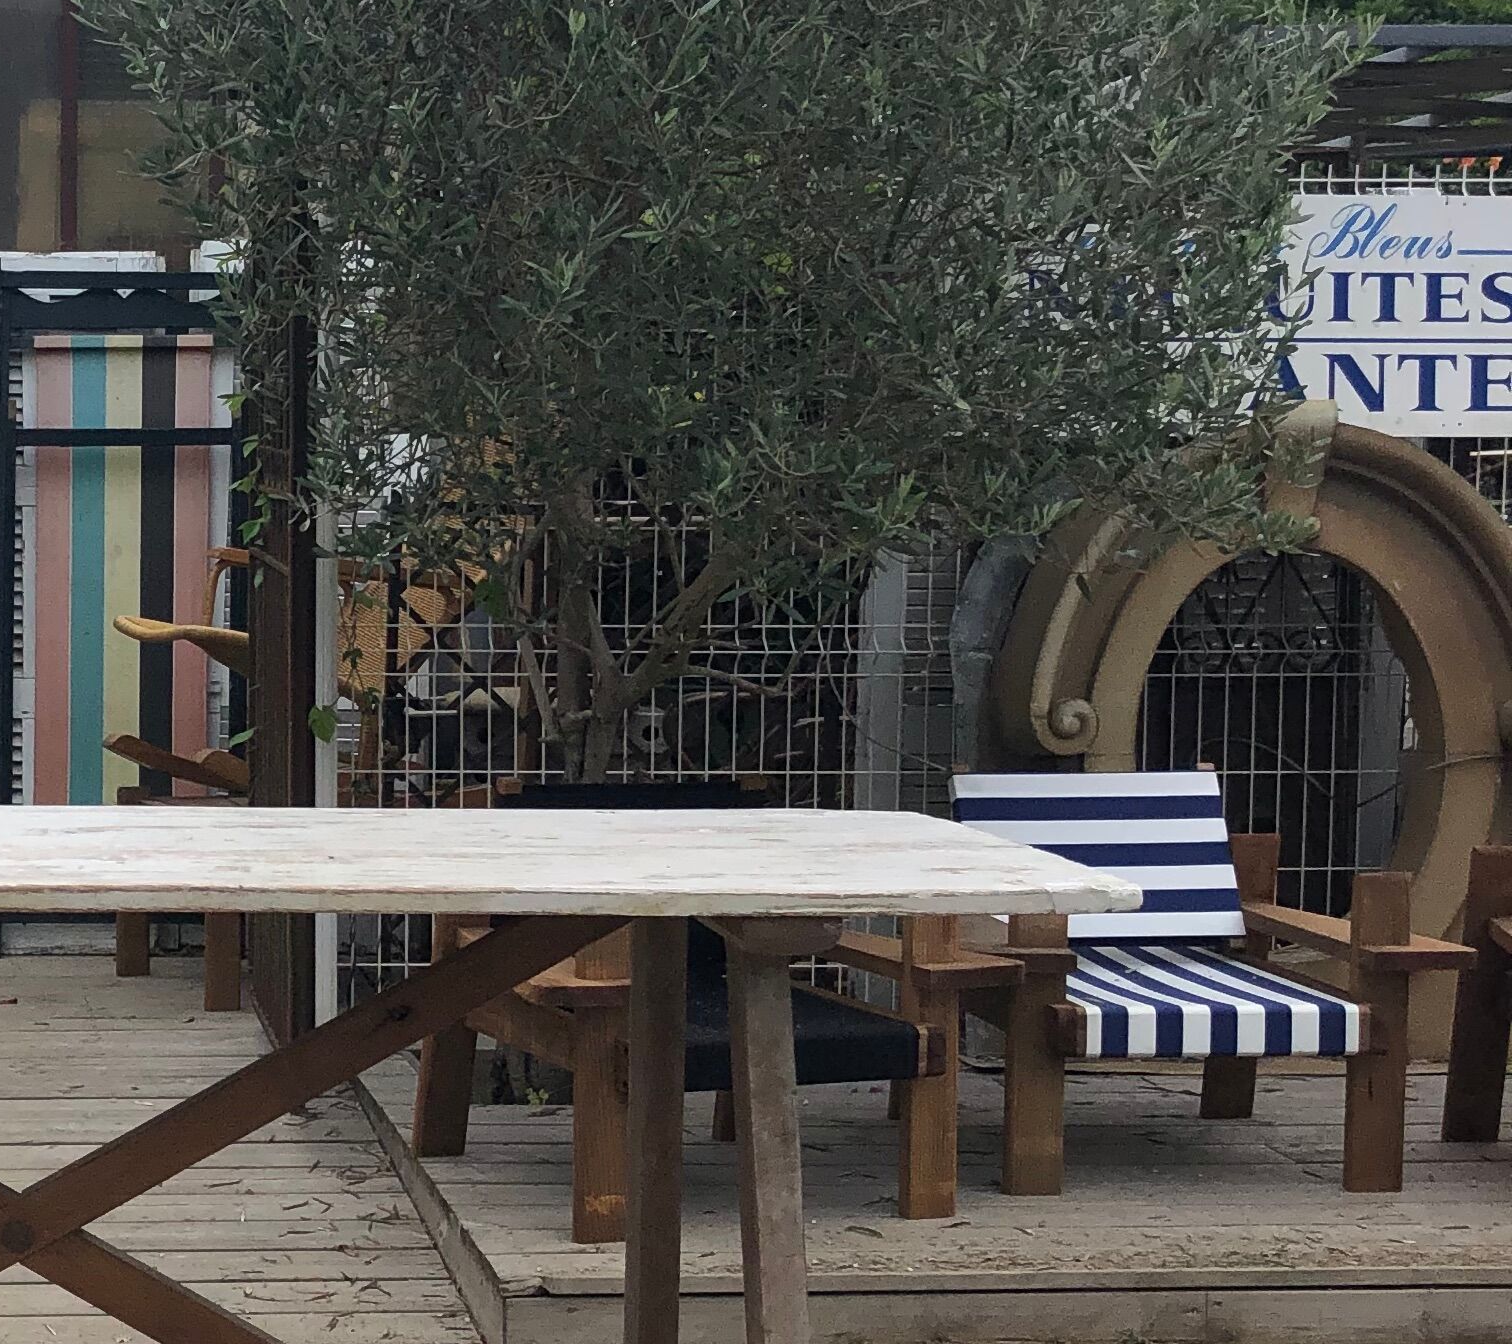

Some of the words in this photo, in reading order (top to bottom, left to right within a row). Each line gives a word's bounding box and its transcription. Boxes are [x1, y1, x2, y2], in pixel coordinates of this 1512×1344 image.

[1309, 202, 1455, 260] Bleus
[1261, 270, 1512, 324] UITES
[1246, 353, 1512, 413] ANTE
